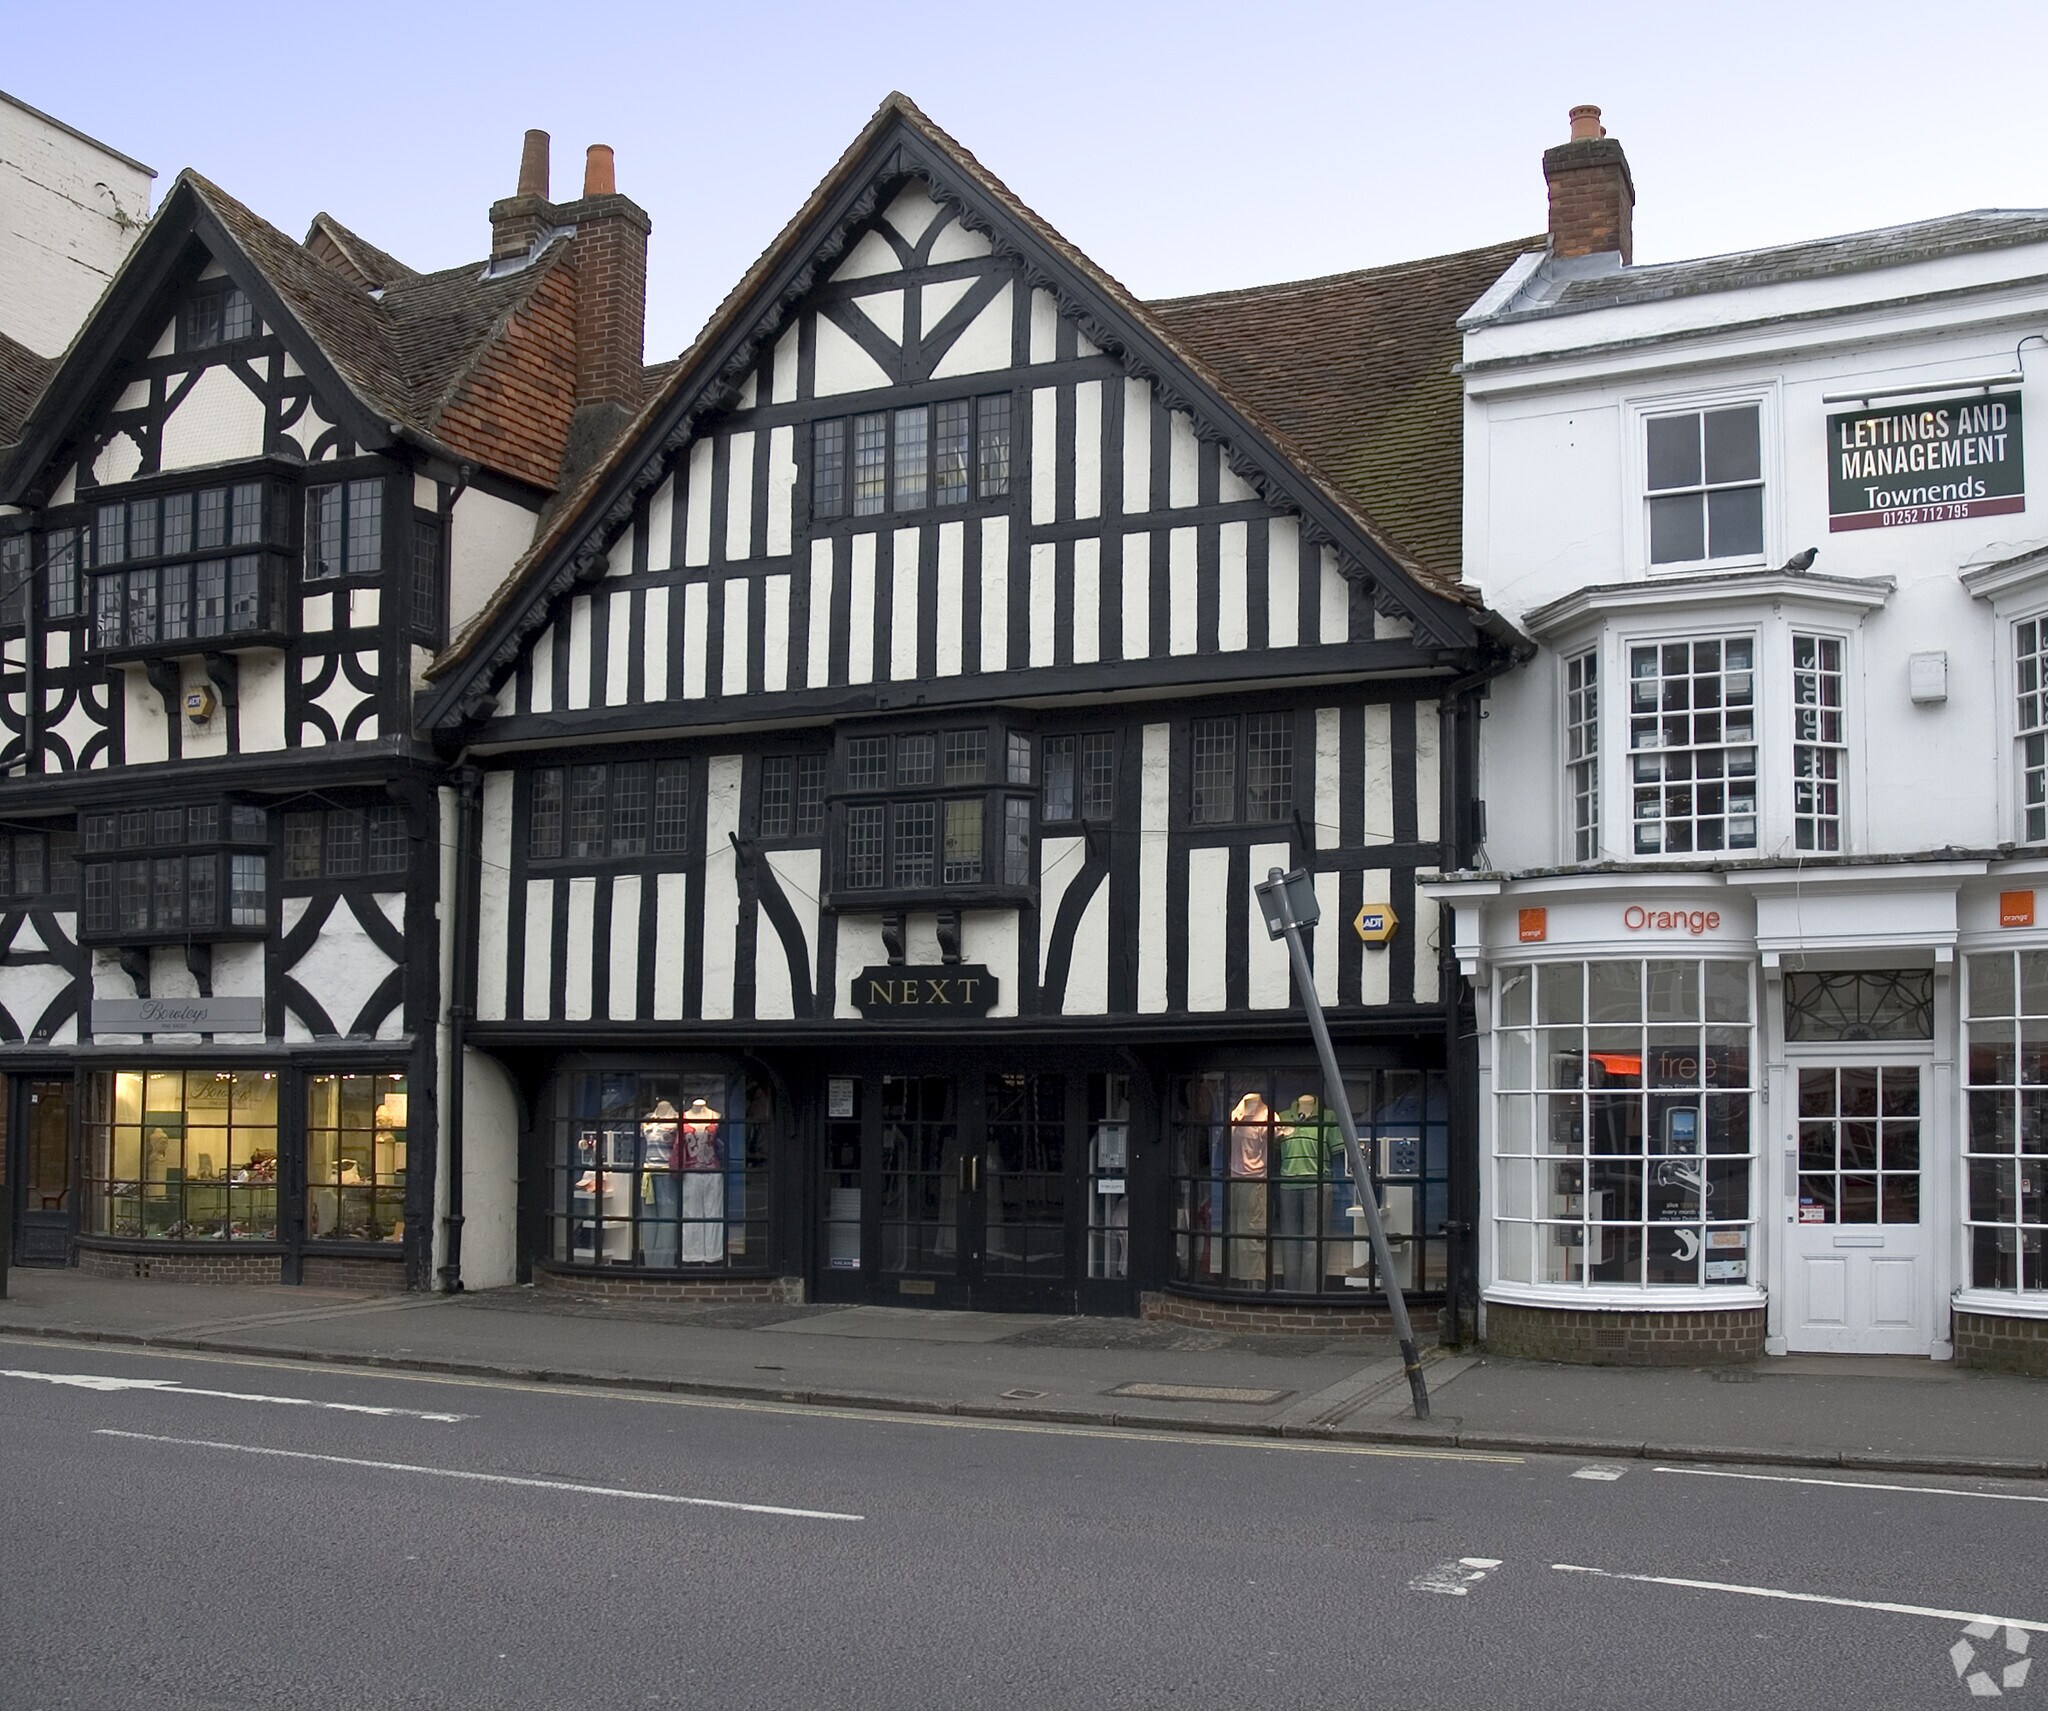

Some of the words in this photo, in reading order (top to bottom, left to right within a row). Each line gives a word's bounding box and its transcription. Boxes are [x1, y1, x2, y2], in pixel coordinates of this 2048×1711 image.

[1841, 408, 1949, 450] LETTINGS
[1958, 403, 2007, 436] AND
[1841, 433, 2007, 480] MANAGEMENT
[1864, 476, 1986, 509] Townends
[1882, 509, 1918, 526] 01252
[1922, 506, 1943, 522] 712
[1947, 503, 1969, 519] 795
[1363, 917, 1383, 928] ADT
[1624, 905, 1720, 934] Orange
[1521, 930, 1541, 938] orange
[868, 979, 980, 1004] NEXT
[140, 1001, 208, 1023] Bowleys
[1659, 1051, 1717, 1079] free
